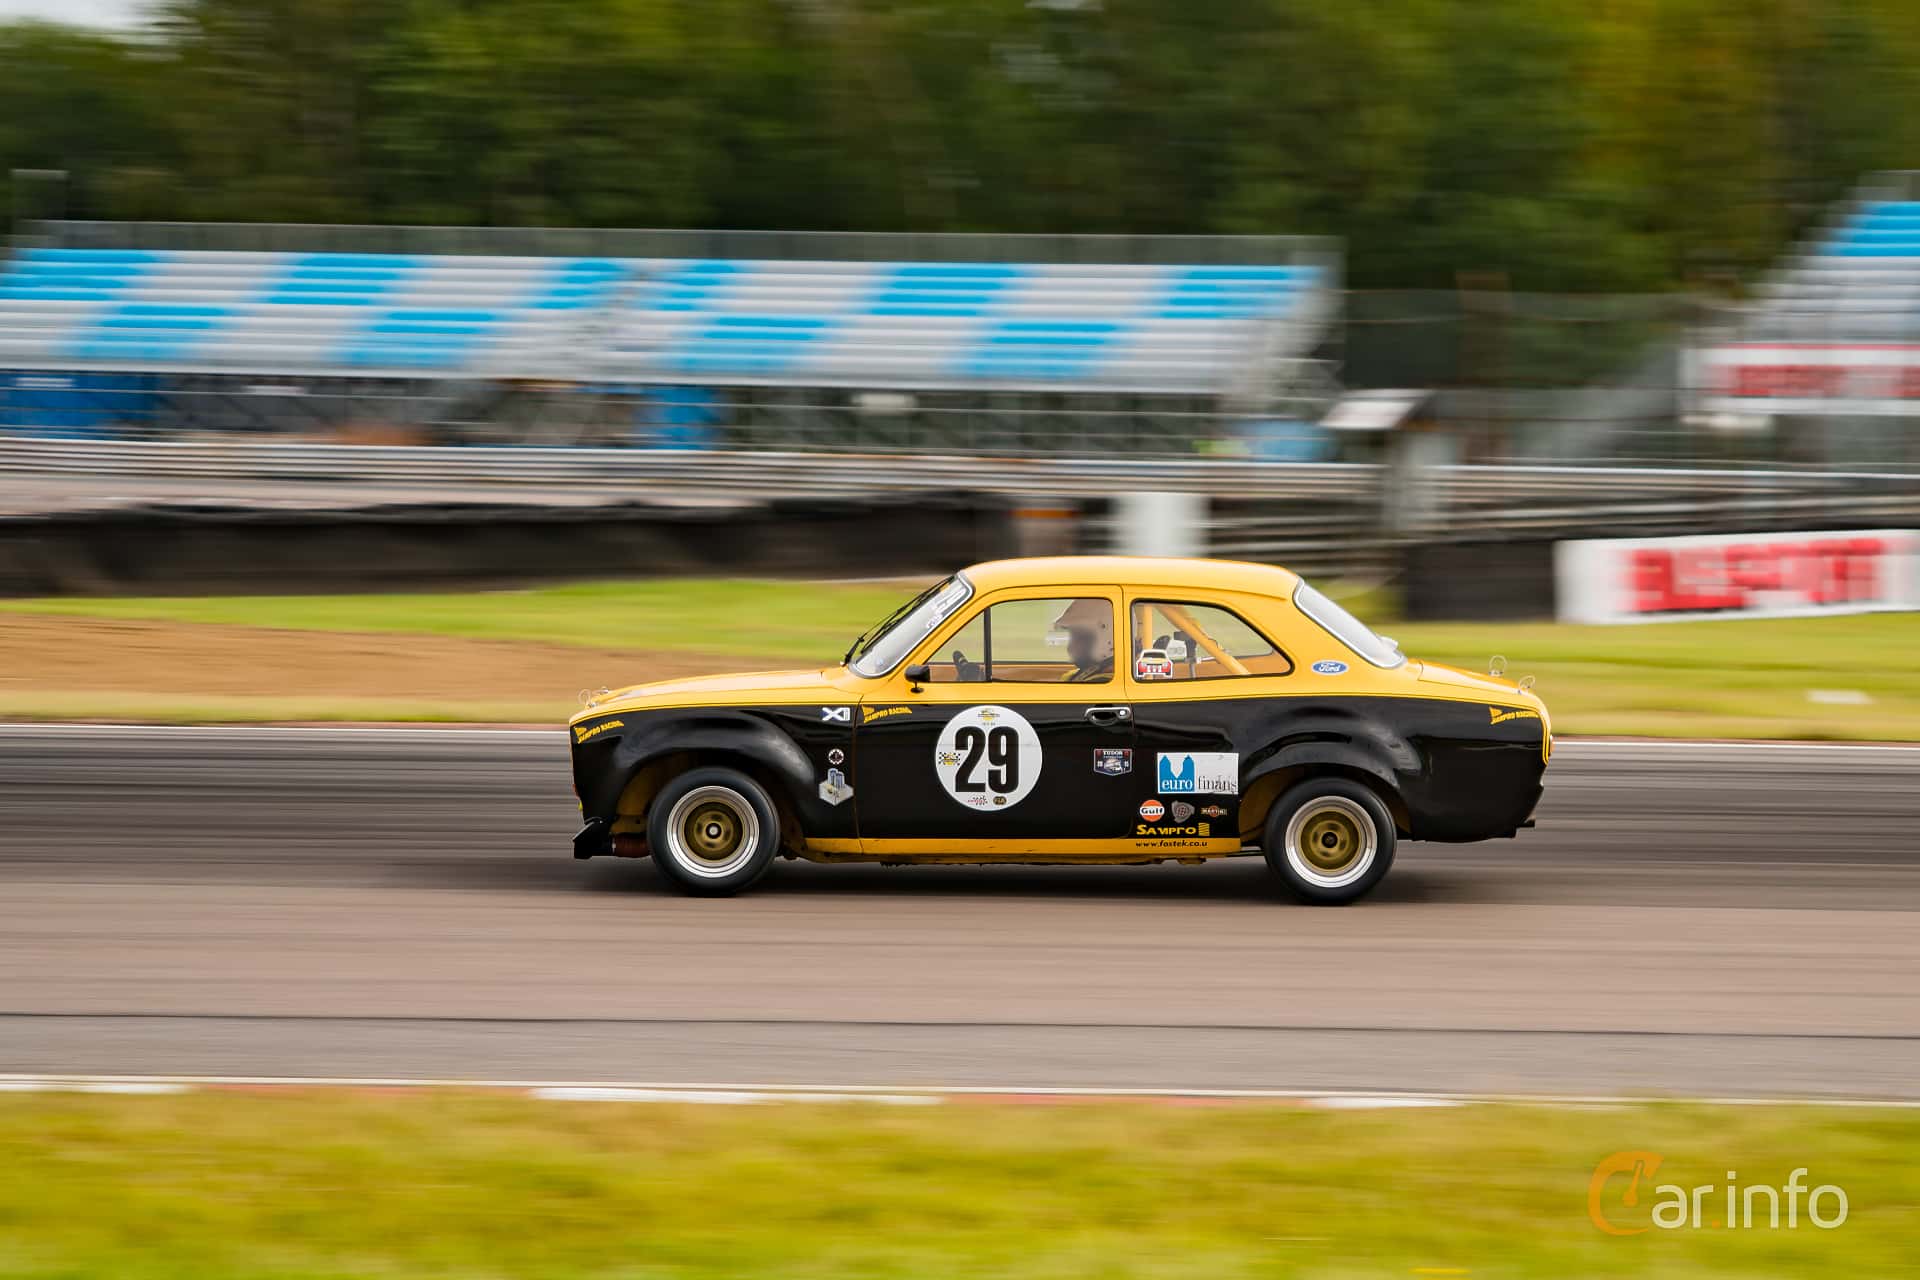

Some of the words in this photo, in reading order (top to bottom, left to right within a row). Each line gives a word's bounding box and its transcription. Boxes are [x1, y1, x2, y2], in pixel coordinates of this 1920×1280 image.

[1318, 662, 1341, 672] Ford
[955, 726, 1019, 794] 29
[1161, 777, 1193, 791] euro
[1140, 806, 1164, 815] Gulf
